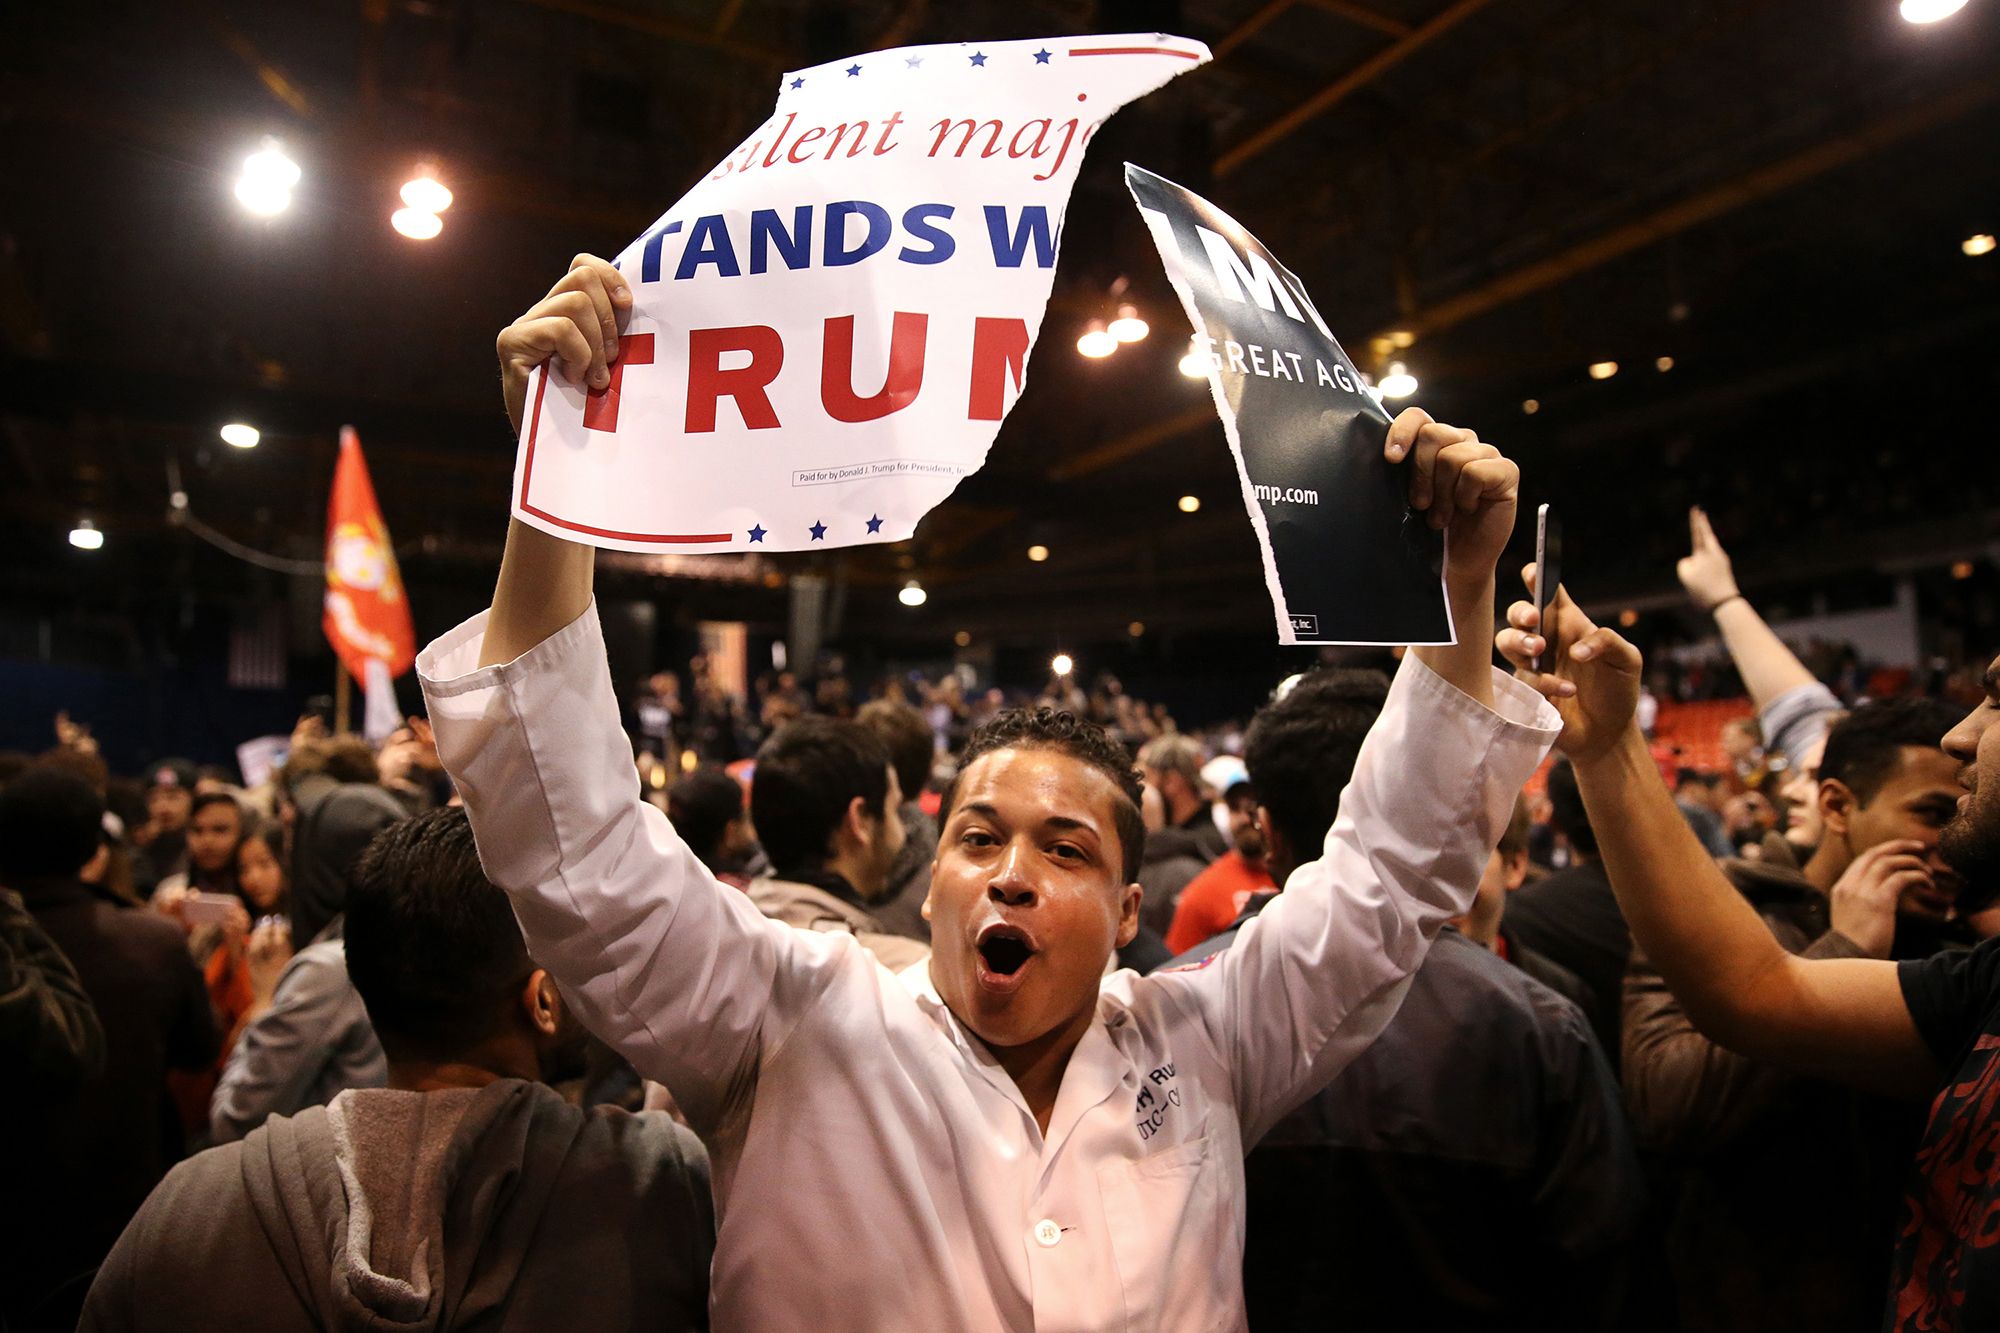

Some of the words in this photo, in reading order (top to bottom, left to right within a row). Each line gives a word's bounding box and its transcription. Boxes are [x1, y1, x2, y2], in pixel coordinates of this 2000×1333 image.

[613, 200, 956, 283] TANDS
[799, 472, 816, 482] Paid
[816, 471, 828, 481] for
[828, 472, 839, 482] by
[839, 466, 864, 478] Donald
[871, 464, 896, 475] Trump
[897, 462, 909, 471] for
[1136, 1086, 1154, 1112] ry
